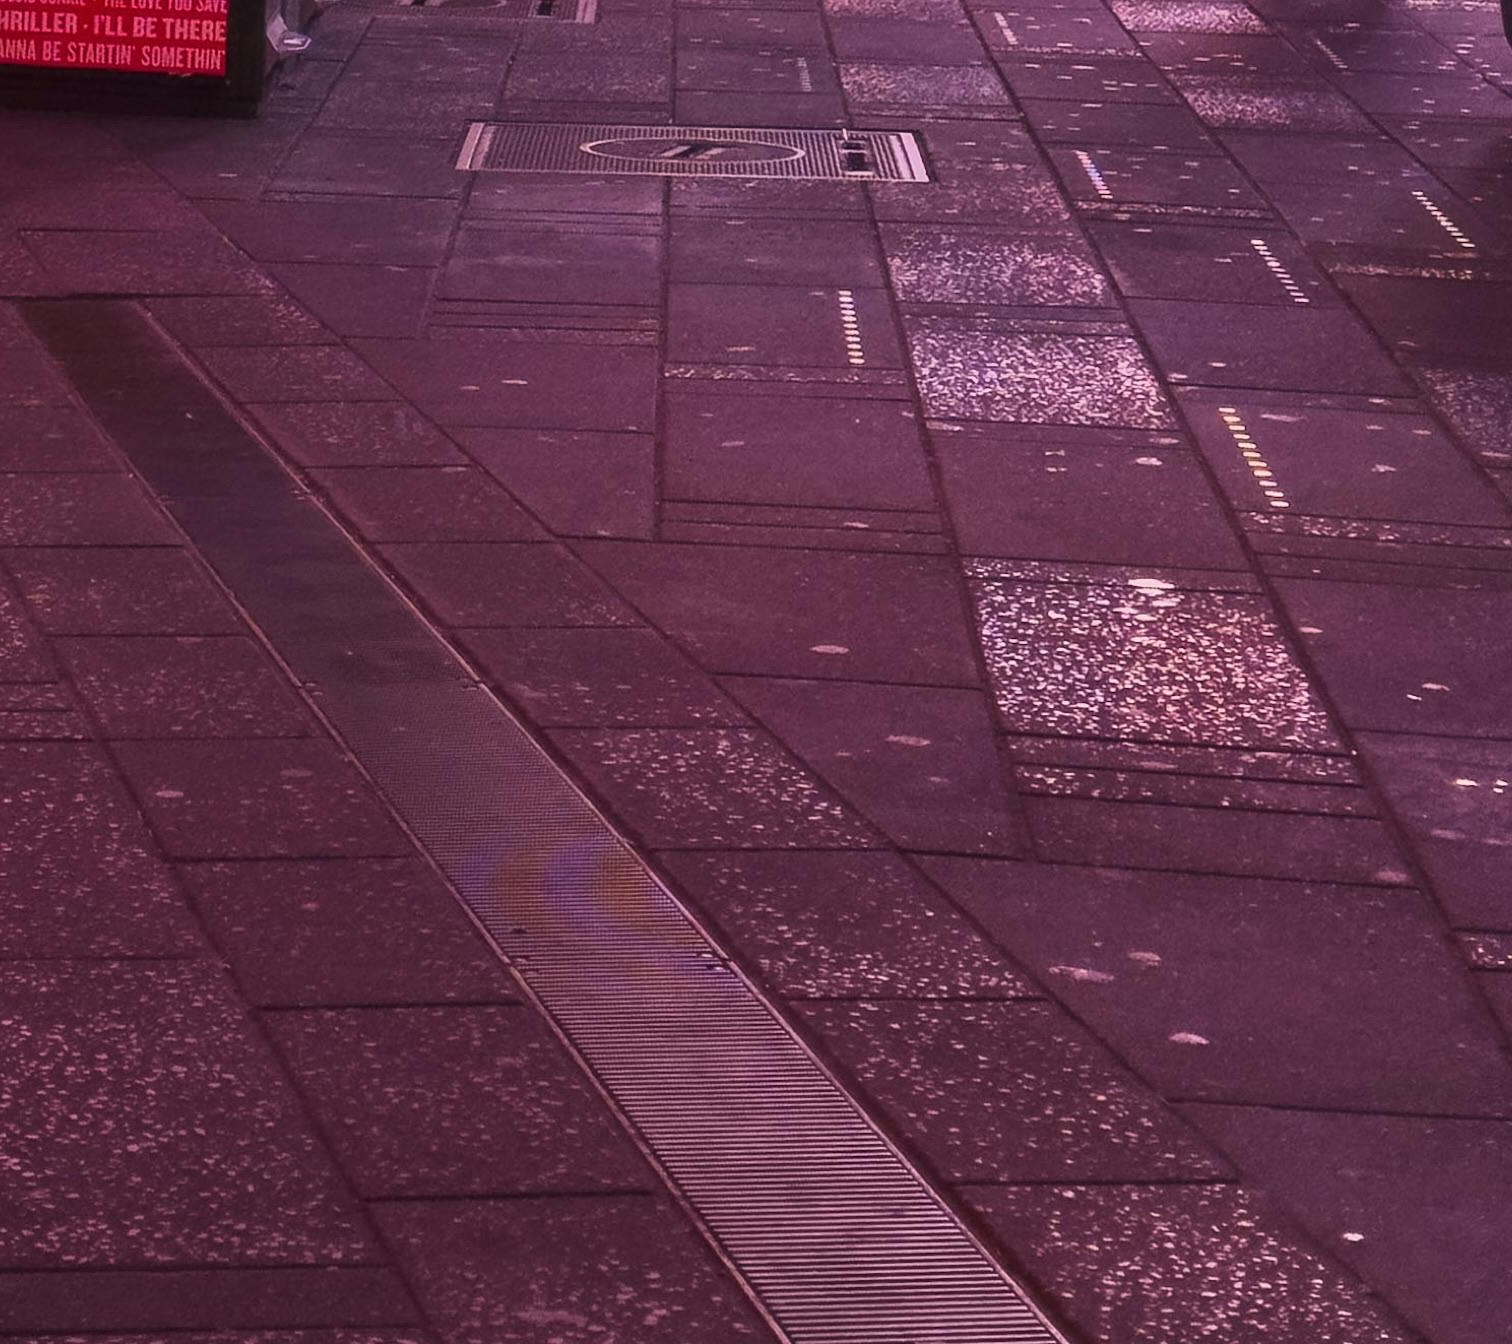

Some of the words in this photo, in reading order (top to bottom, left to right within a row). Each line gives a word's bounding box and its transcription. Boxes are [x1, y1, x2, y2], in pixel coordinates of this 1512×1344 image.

[94, 15, 127, 37] I'LL
[133, 17, 157, 38] BE
[163, 18, 226, 42] THERE
[42, 41, 61, 62] BE
[67, 43, 136, 66] STARTIN'
[141, 46, 225, 70] SOMETHIN'
